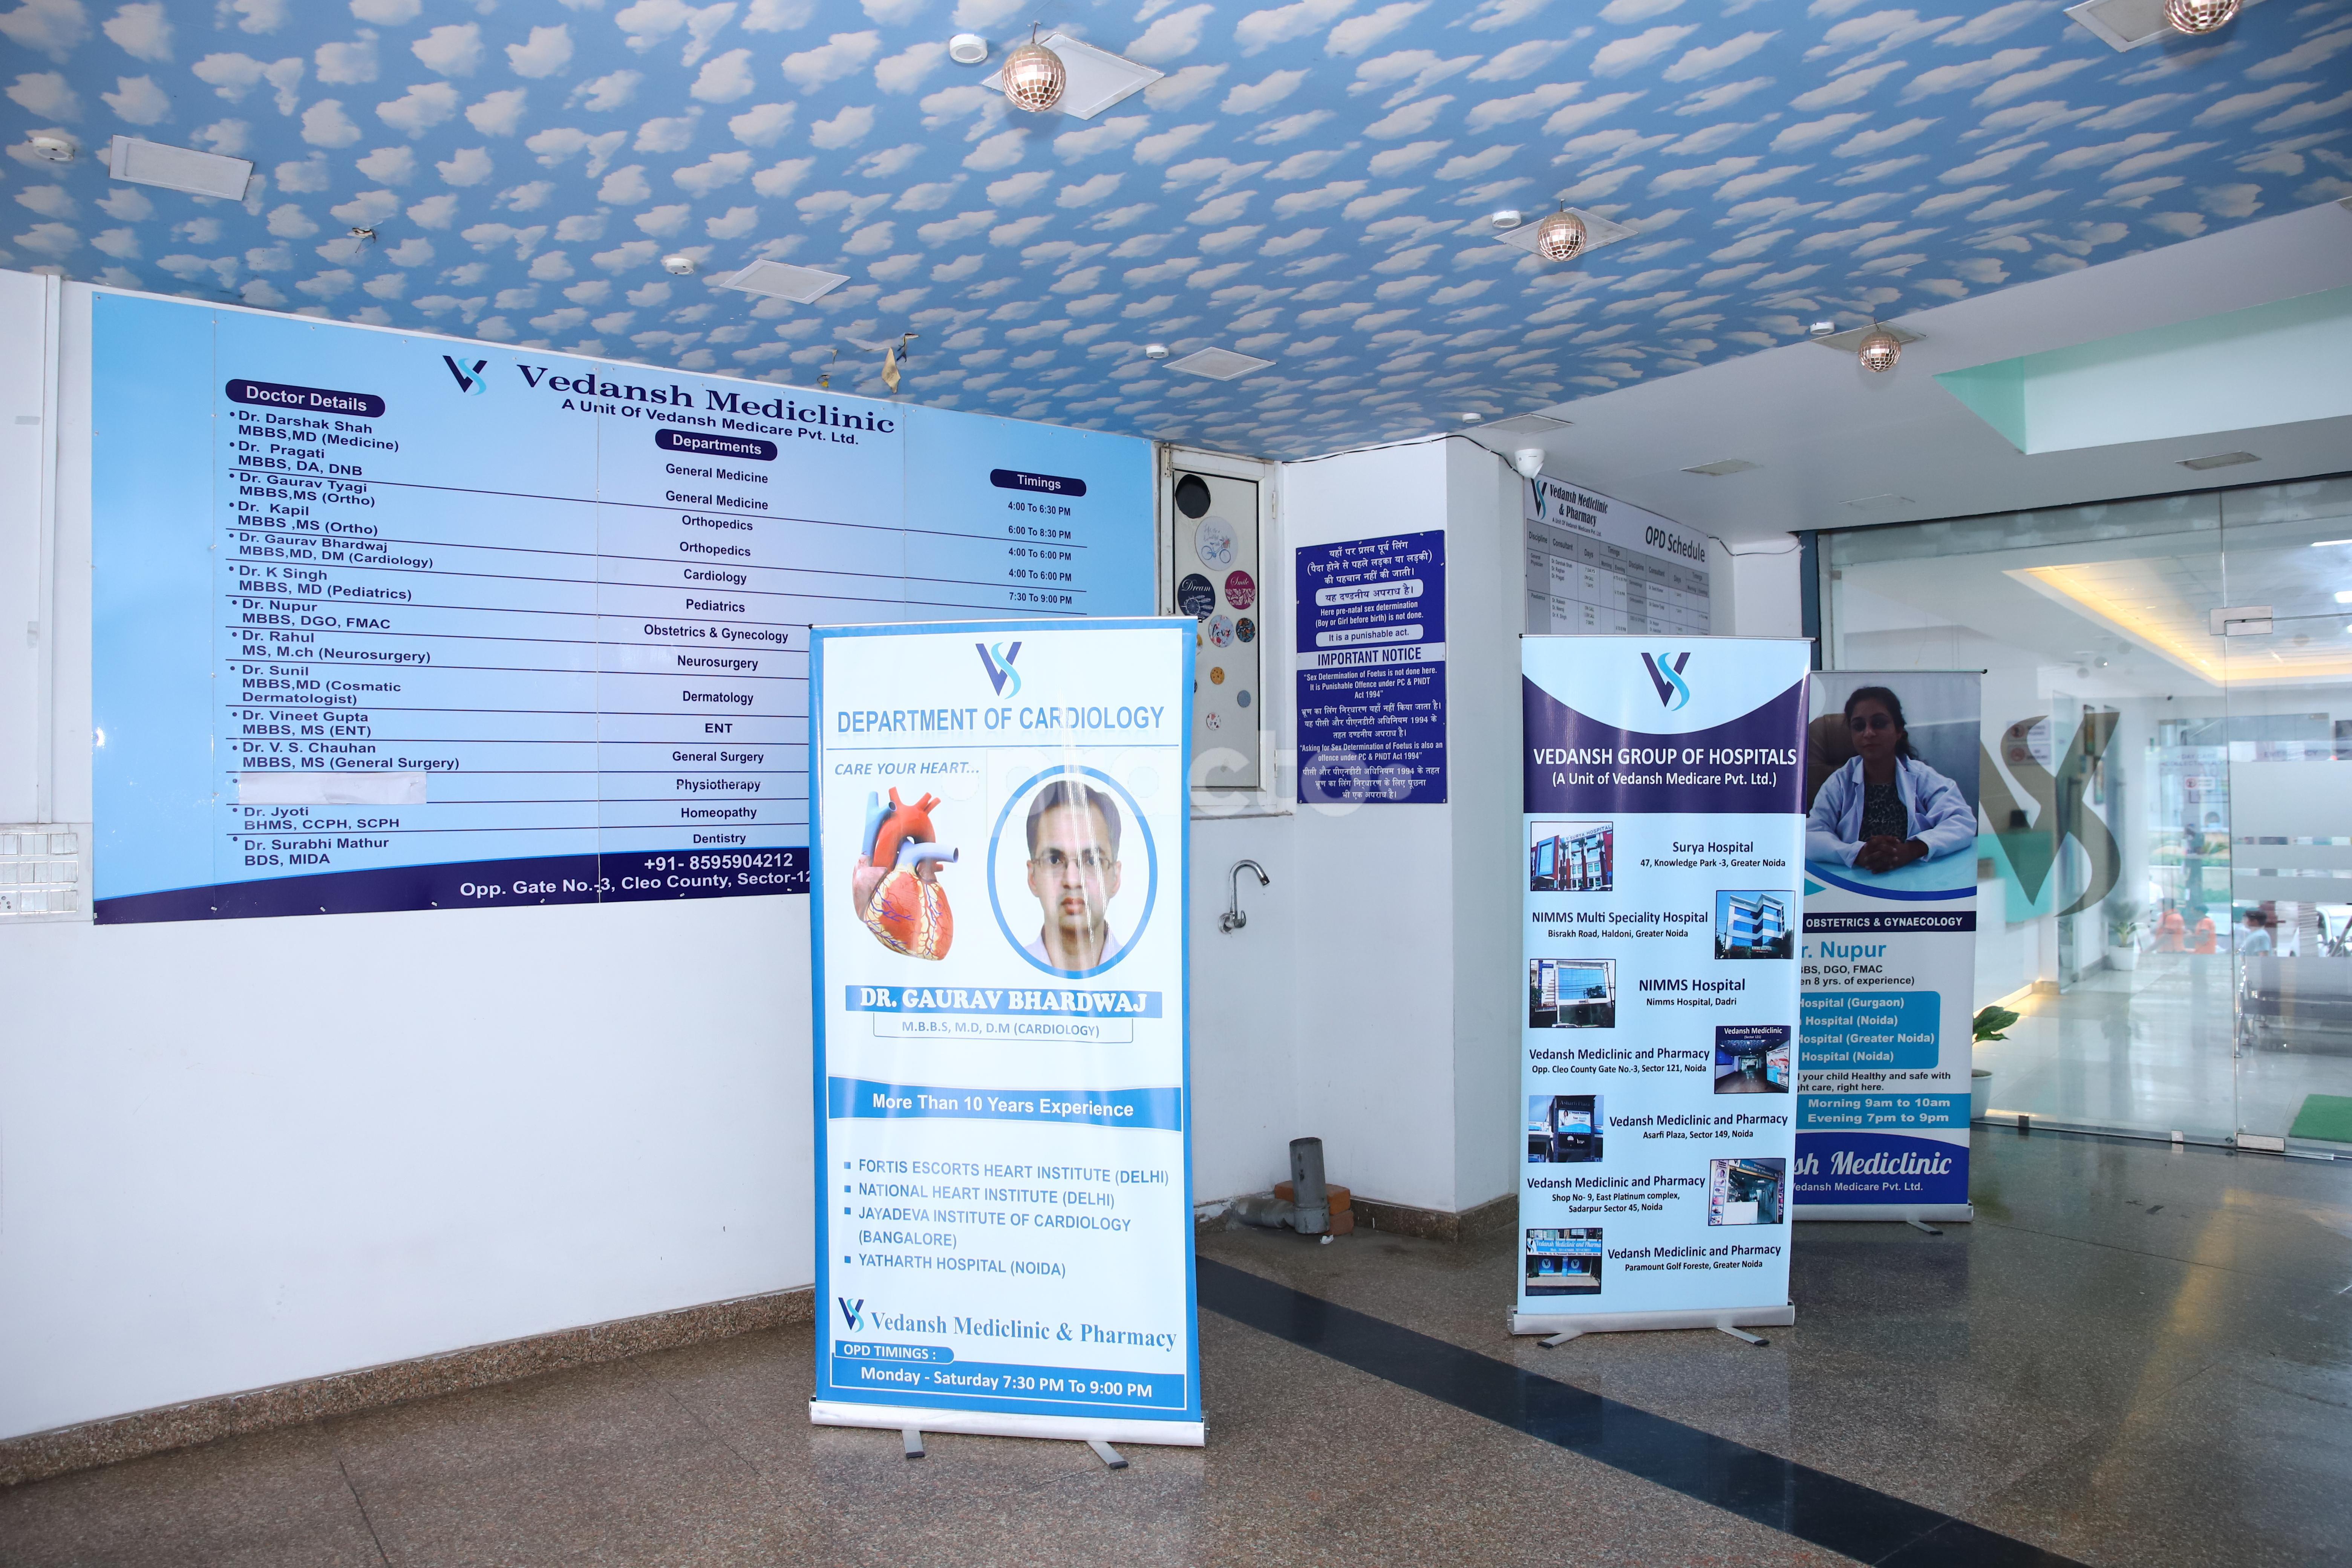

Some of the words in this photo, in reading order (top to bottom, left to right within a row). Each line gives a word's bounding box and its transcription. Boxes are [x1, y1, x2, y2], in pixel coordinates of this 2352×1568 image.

[247, 385, 305, 404] Doctor
[310, 393, 367, 412] Details
[517, 364, 695, 409] Vedansh
[705, 389, 895, 434] Mediclinic
[239, 410, 260, 422] Dr.
[266, 413, 329, 430] Darshak
[334, 421, 372, 434] Shah
[561, 398, 575, 410] A
[580, 400, 616, 415] Unit
[621, 406, 642, 418] Of
[645, 408, 716, 427] Vedansh
[722, 418, 793, 436] Medicare
[798, 427, 826, 441] Pvt.
[831, 432, 859, 445] Ltd.
[239, 424, 317, 443] MBBS,MD
[322, 433, 399, 452] (Medicine)
[673, 433, 762, 455] Departments
[666, 463, 712, 478] General
[717, 468, 768, 484] Medicine
[1017, 474, 1061, 491] Timings
[1550, 484, 1577, 504] Vedansh
[1577, 493, 1608, 514] Mediclinic
[1008, 501, 1025, 511] 4:00
[1027, 503, 1037, 513] To
[1039, 504, 1056, 514] 6:30
[1058, 506, 1070, 516] PM
[1559, 503, 1565, 516] &
[1566, 505, 1597, 529] Pharmacy
[240, 532, 259, 542] Dr.
[265, 534, 317, 546] Gaurav
[322, 538, 387, 553] Bhardwaj
[1329, 546, 1343, 558] यहाँ
[1344, 547, 1357, 556] पर
[1358, 545, 1375, 554] प्रसव
[1377, 540, 1390, 555] पूर्व
[1391, 540, 1409, 550] लिंग
[1529, 531, 1548, 544] Discipline
[1553, 539, 1573, 551] Consultant
[1584, 549, 1594, 559] Days
[1608, 546, 1620, 557] Timings
[1645, 526, 1666, 548] OPD
[1667, 533, 1706, 562] Schedule
[239, 545, 317, 561] MBBS,MD,
[322, 550, 344, 561] DM
[349, 552, 433, 569] (Cardiology)
[684, 568, 747, 585] Cardiology
[1181, 579, 1211, 592] Dream
[1230, 576, 1249, 585] Smile
[1325, 594, 1337, 602] यह
[1339, 589, 1370, 601] दण्डनीय
[1373, 588, 1401, 597] अपराध
[1402, 583, 1413, 596] है।
[1336, 605, 1363, 617] pre-natal
[1376, 600, 1418, 611] determination
[644, 624, 706, 637] Obstetrics
[709, 627, 718, 638] &
[721, 628, 789, 644] Gynecology
[1351, 629, 1393, 642] punishable
[1395, 628, 1409, 637] act.
[1318, 650, 1379, 666] IMPORTANT
[1382, 647, 1421, 662] NOTICE
[838, 708, 978, 733] DEPARTMENT
[984, 707, 1012, 730] OF
[1019, 706, 1164, 729] CARDIOLOGY
[1533, 748, 1613, 766] VEDANSH
[1618, 748, 1677, 765] GROUP
[1682, 748, 1704, 765] OF
[1709, 748, 1797, 765] HOSPITALS
[835, 763, 873, 775] CARE
[877, 763, 916, 775] YOUR
[677, 779, 761, 793] Physiotherapy
[245, 840, 266, 851] Dr.
[271, 838, 331, 850] Surabhi
[337, 838, 389, 848] Mathur
[1672, 841, 1704, 855] Surya
[1708, 841, 1753, 855] Hospital
[245, 854, 283, 867] BDS,
[289, 853, 331, 865] MIDA
[644, 856, 684, 871] +91-
[689, 853, 793, 870] 8595904212
[1640, 859, 1652, 868] 47,
[1654, 858, 1698, 868] Knowledge
[1700, 859, 1717, 867] Park
[1719, 859, 1729, 868] -3,
[1730, 859, 1761, 867] Greater
[460, 882, 506, 899] Opp.
[513, 880, 556, 894] Gate
[563, 877, 615, 893] No.-3,
[621, 876, 661, 890] Cleo
[667, 874, 732, 889] County,
[1532, 912, 1573, 923] NIMMS
[1577, 911, 1605, 923] Multi
[1608, 911, 1660, 925] Speciality
[1663, 911, 1708, 925] Hospital
[1806, 918, 1870, 928] OBSTETRICS
[1873, 917, 1881, 926] &
[1884, 917, 1963, 926] GYNAECOLOGY
[1821, 941, 1886, 962] Nupur
[1824, 965, 1850, 975] DGO,
[1853, 965, 1883, 973] FMAC
[859, 986, 897, 1008] DR.
[902, 989, 1003, 1009] GAURAV
[1008, 991, 1147, 1012] BHARDWAJ
[1801, 1051, 1849, 1063] Hospital
[1853, 1051, 1894, 1063] (Noida)
[1851, 1072, 1886, 1082] Healthy
[1909, 1072, 1928, 1080] safe
[1808, 1098, 1861, 1109] Morning
[1865, 1098, 1893, 1107] 9am
[1896, 1098, 1910, 1107] to
[1915, 1098, 1950, 1107] 10am
[1643, 1130, 1664, 1139] Asarfi
[1666, 1130, 1687, 1140] Plaza,
[1715, 1130, 1730, 1139] 149,
[1732, 1129, 1753, 1138] Noida
[1830, 1151, 1952, 1175] Mediclinic
[858, 1253, 932, 1269] YATHARTH
[937, 1257, 1006, 1273] HOSPITAL
[1011, 1260, 1066, 1279] (NOIDA)
[844, 1344, 871, 1356] OPD
[873, 1345, 929, 1360] TIMINGS
